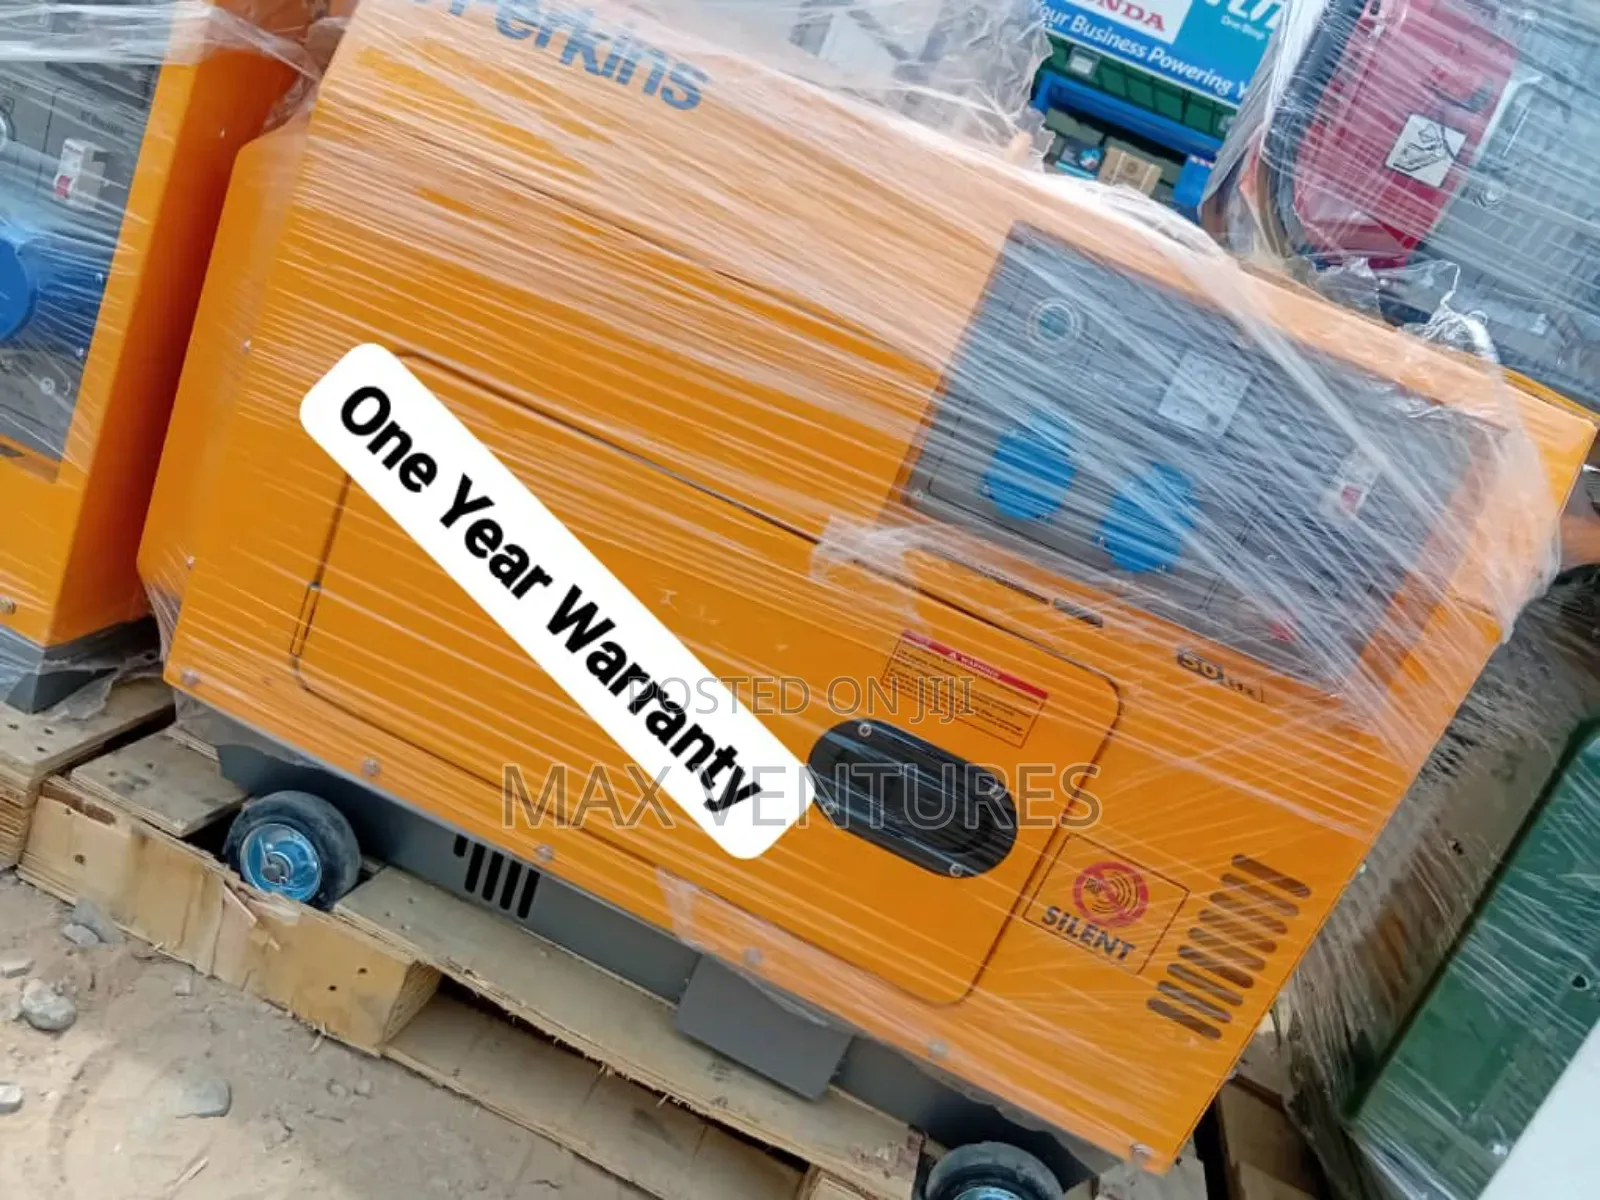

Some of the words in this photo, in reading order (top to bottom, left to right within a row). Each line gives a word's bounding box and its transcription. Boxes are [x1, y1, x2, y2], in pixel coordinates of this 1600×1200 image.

[1094, 0, 1166, 32] NDA
[449, 0, 711, 111] erkins
[1070, 14, 1148, 58] Business
[1147, 46, 1235, 97] Powering
[1041, 905, 1136, 961] SILENT
